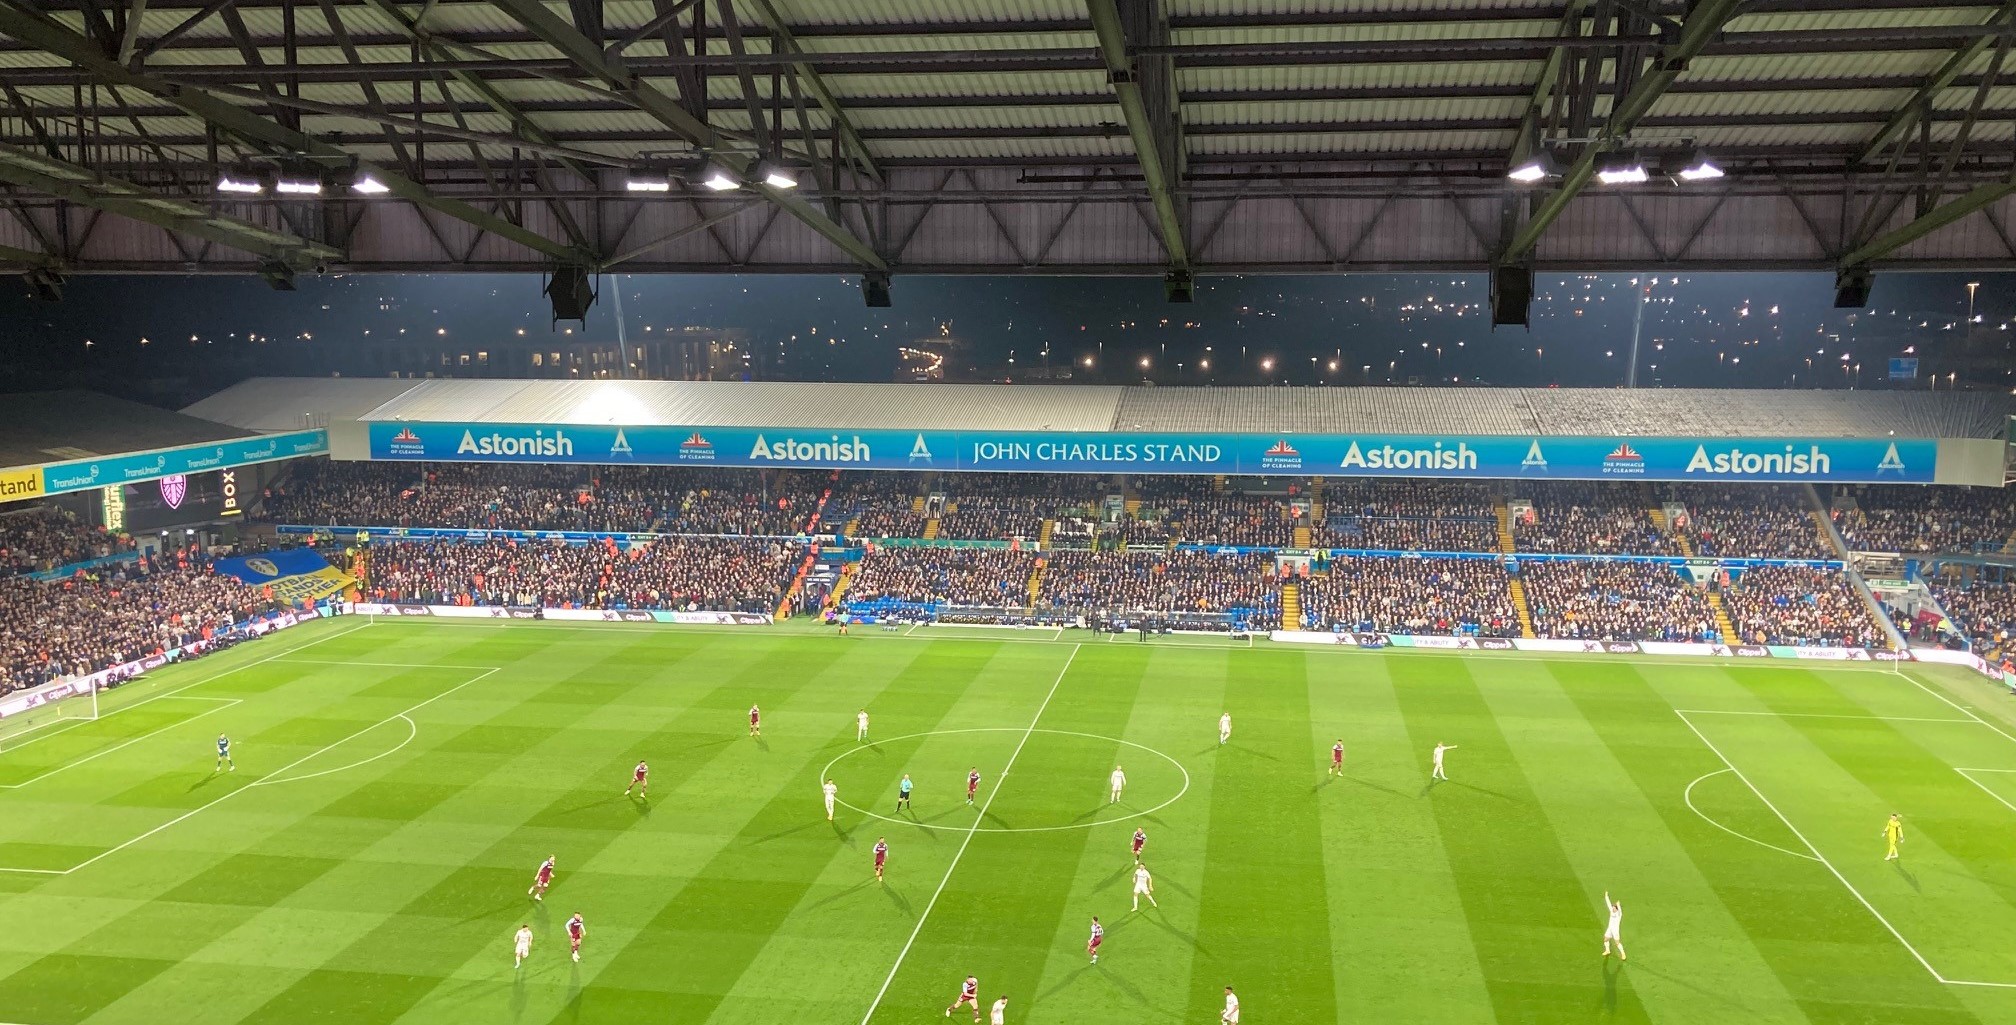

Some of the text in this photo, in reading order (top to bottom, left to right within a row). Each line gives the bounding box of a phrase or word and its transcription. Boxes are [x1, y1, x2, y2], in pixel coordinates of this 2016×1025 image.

[243, 449, 273, 460] TransUnion
[457, 429, 573, 456] Astonish
[750, 434, 870, 462] Astonish
[973, 442, 1221, 463] JOHN CHARLES STAND
[187, 458, 220, 469] TransUnion
[1340, 440, 1477, 470] Astonish
[1685, 444, 1830, 474] Astonish
[53, 475, 94, 489] TransUnion
[124, 466, 162, 478] TransUnion
[222, 467, 237, 508] BOX
